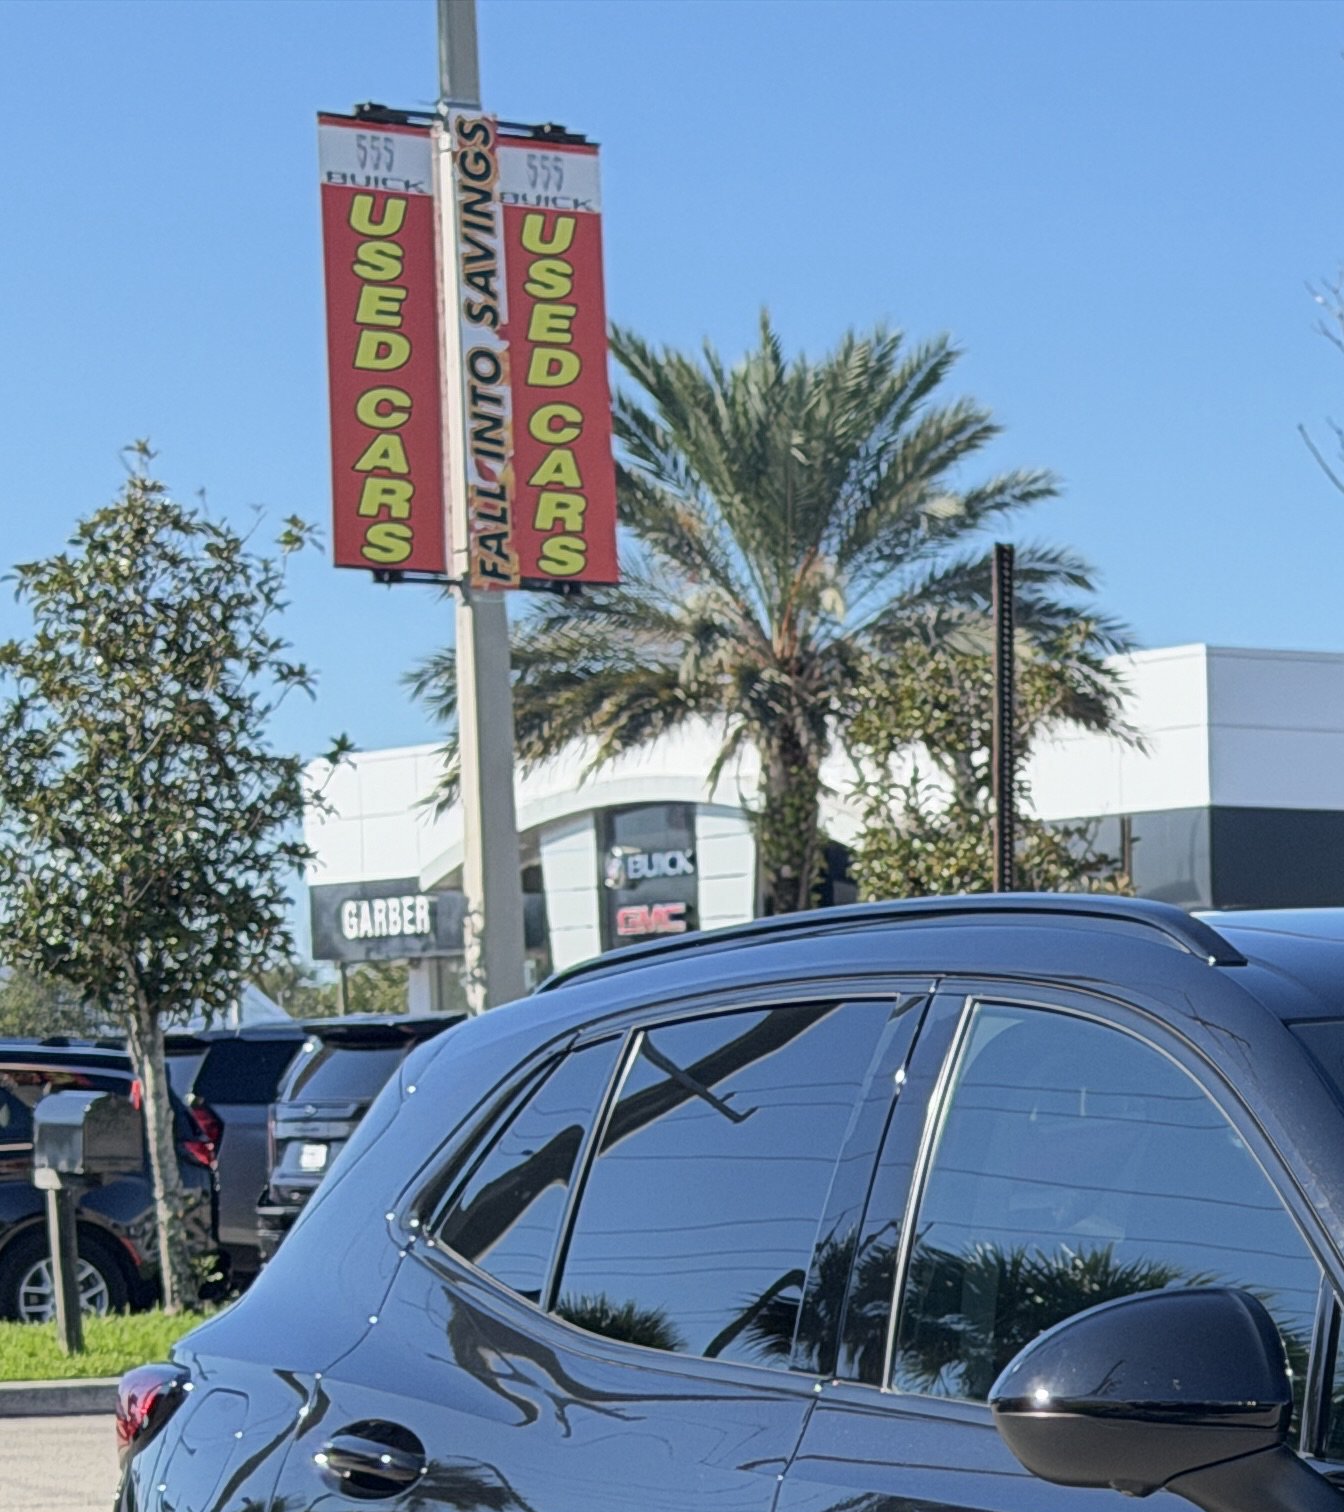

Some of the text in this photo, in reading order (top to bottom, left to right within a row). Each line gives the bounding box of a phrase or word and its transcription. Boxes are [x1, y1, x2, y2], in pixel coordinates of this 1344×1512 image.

[326, 170, 425, 193] BUICK
[457, 114, 512, 582] FALL INTO SAVINGS
[347, 193, 415, 565] USED CARS
[520, 212, 588, 578] USED CARS
[627, 850, 694, 880] BUICK
[341, 895, 431, 940] GARBER
[617, 902, 686, 936] GMC
